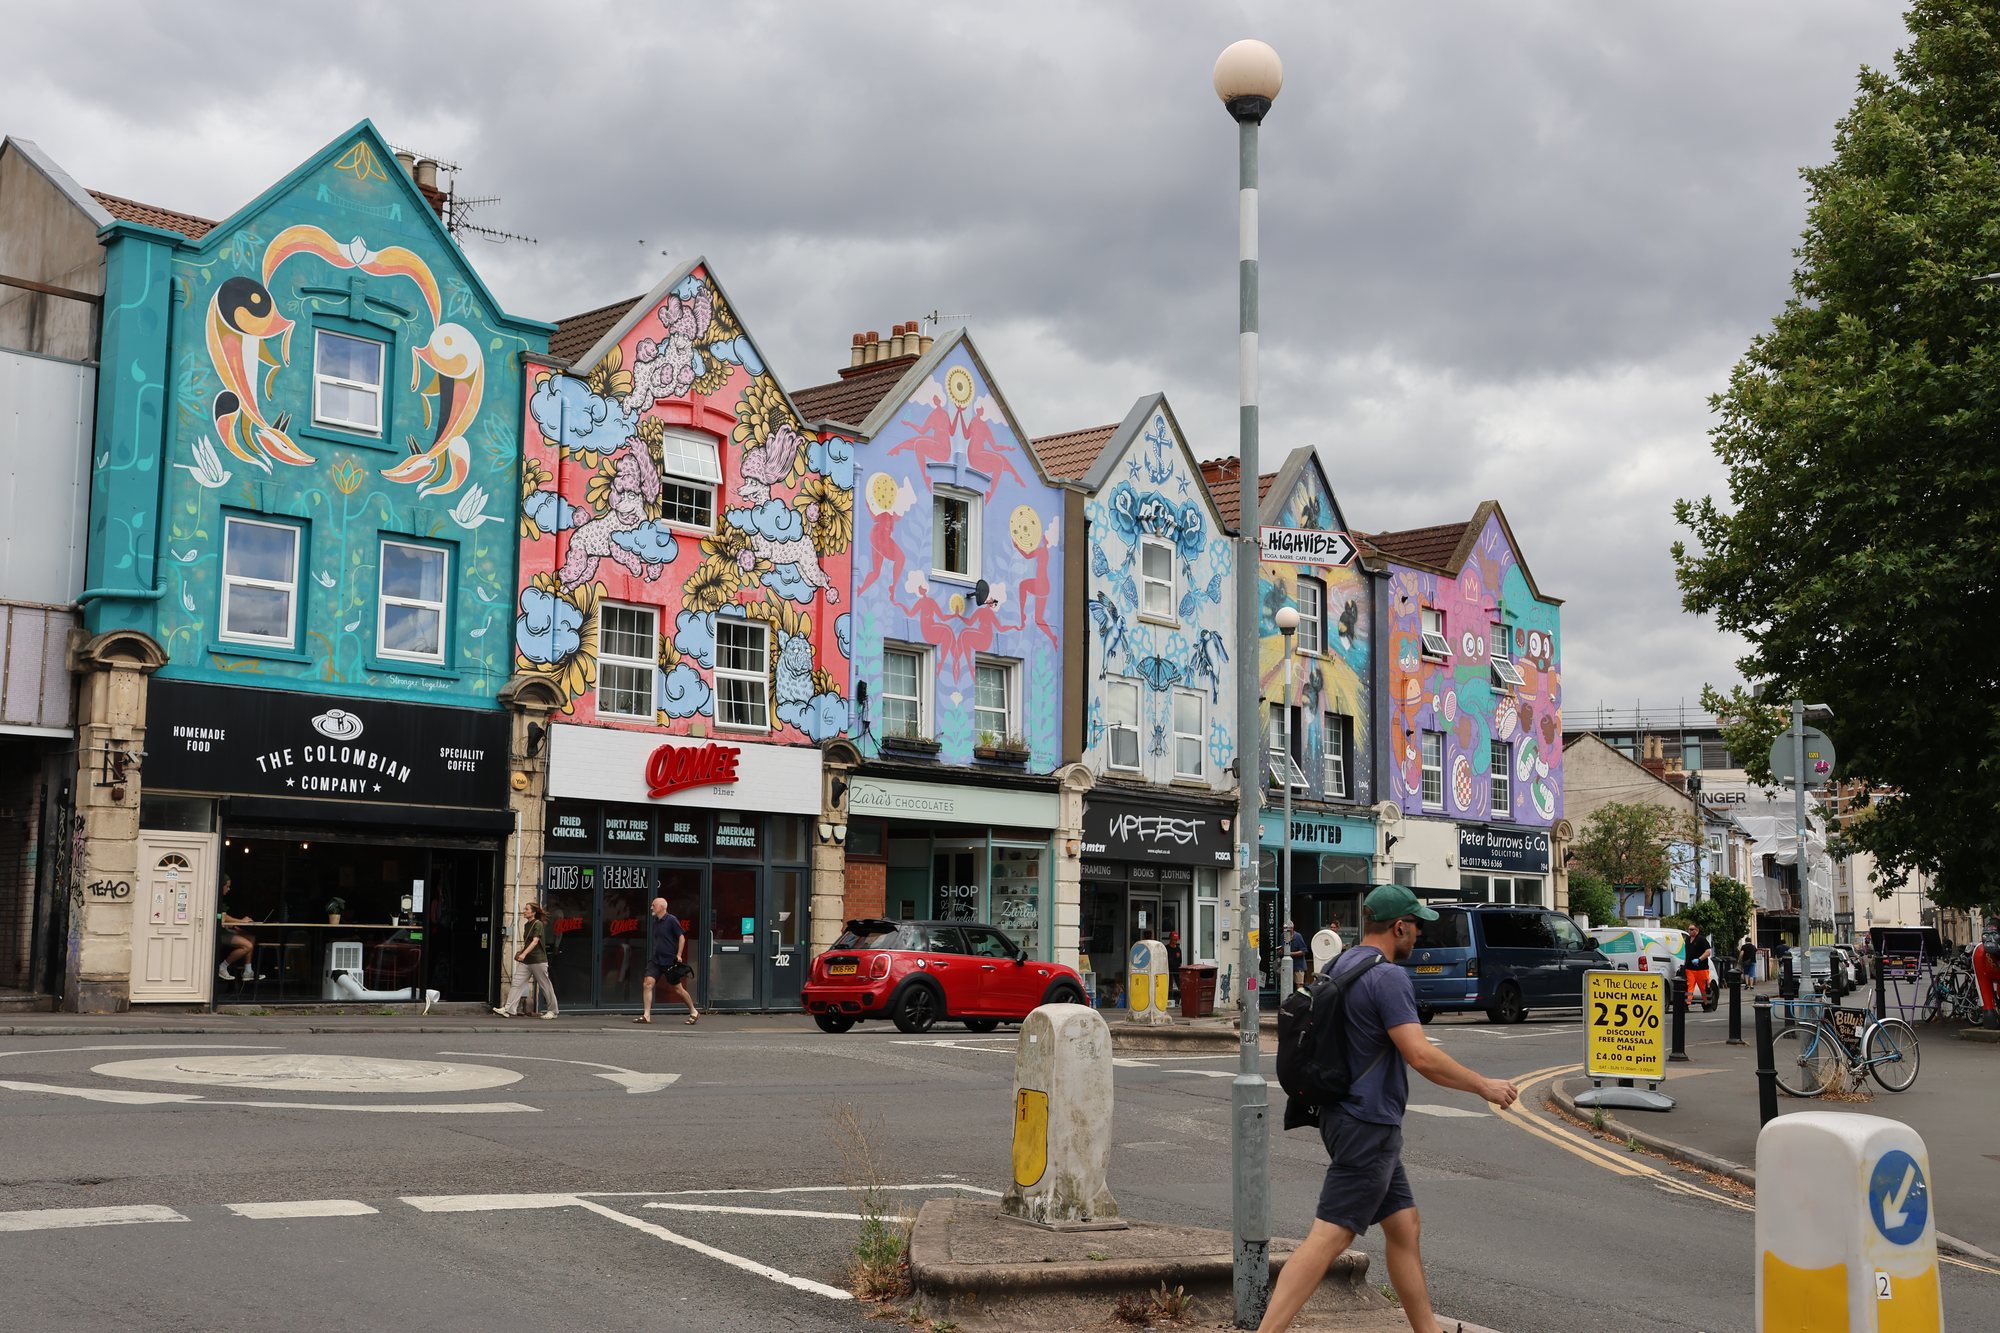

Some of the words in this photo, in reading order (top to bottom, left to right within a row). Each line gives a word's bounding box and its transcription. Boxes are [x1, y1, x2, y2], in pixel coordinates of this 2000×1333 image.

[173, 725, 226, 741] HOMEMADE
[187, 740, 211, 753] FOOD
[440, 747, 485, 761] SPECIALITY
[256, 748, 294, 773] THE
[304, 745, 412, 784] COLOMBIAN
[447, 760, 476, 772] COFFEE
[645, 743, 741, 795] OOWEE
[301, 775, 367, 794] COMPANY
[712, 786, 735, 797] Diner
[850, 784, 891, 807] Zara's
[895, 798, 954, 812] CHOCOLATES
[559, 815, 581, 827] FRIED
[606, 818, 627, 829] DIRTY
[629, 820, 648, 831] FRIES
[673, 822, 691, 833] BEEF
[552, 826, 587, 839] CHICKEN.
[608, 830, 616, 840] &
[616, 830, 646, 841] SHAKES.
[717, 825, 755, 837] AMERICAN
[664, 832, 699, 845] BURGERS.
[716, 835, 756, 848] BREAKFAST.
[1460, 829, 1485, 846] Peter
[1487, 832, 1523, 849] Burrows
[1524, 835, 1533, 850] &
[1534, 836, 1548, 852] Co.
[1214, 851, 1231, 861] POSCA
[1491, 849, 1522, 859] SOLICITORS
[1460, 857, 1469, 866] Tel:
[1468, 857, 1480, 866] 0117
[1481, 858, 1490, 867] 963
[1490, 859, 1503, 868] 6366
[1540, 863, 1548, 871] 194
[1081, 864, 1111, 876] FRAMING
[1133, 867, 1155, 878] BOOKS
[548, 866, 579, 890] HITS
[940, 885, 979, 898] SHOP
[552, 918, 583, 934] OOWEE
[610, 919, 639, 935] OOWEE
[775, 954, 790, 967] 202
[1603, 978, 1621, 989] The
[1623, 979, 1647, 990] Clove
[1593, 991, 1628, 1000] LUNCH
[1630, 992, 1658, 1002] MEAL
[1593, 1002, 1659, 1029] 25%
[1834, 1010, 1864, 1030] Billy's
[1606, 1029, 1646, 1037] DISCOUNT
[1839, 1024, 1854, 1035] Bike
[1616, 1037, 1654, 1045] MASSALA
[1616, 1044, 1635, 1052] CHAI
[1596, 1052, 1622, 1061] £4.00
[1635, 1053, 1656, 1064] pint
[1879, 1276, 1890, 1297] 2
